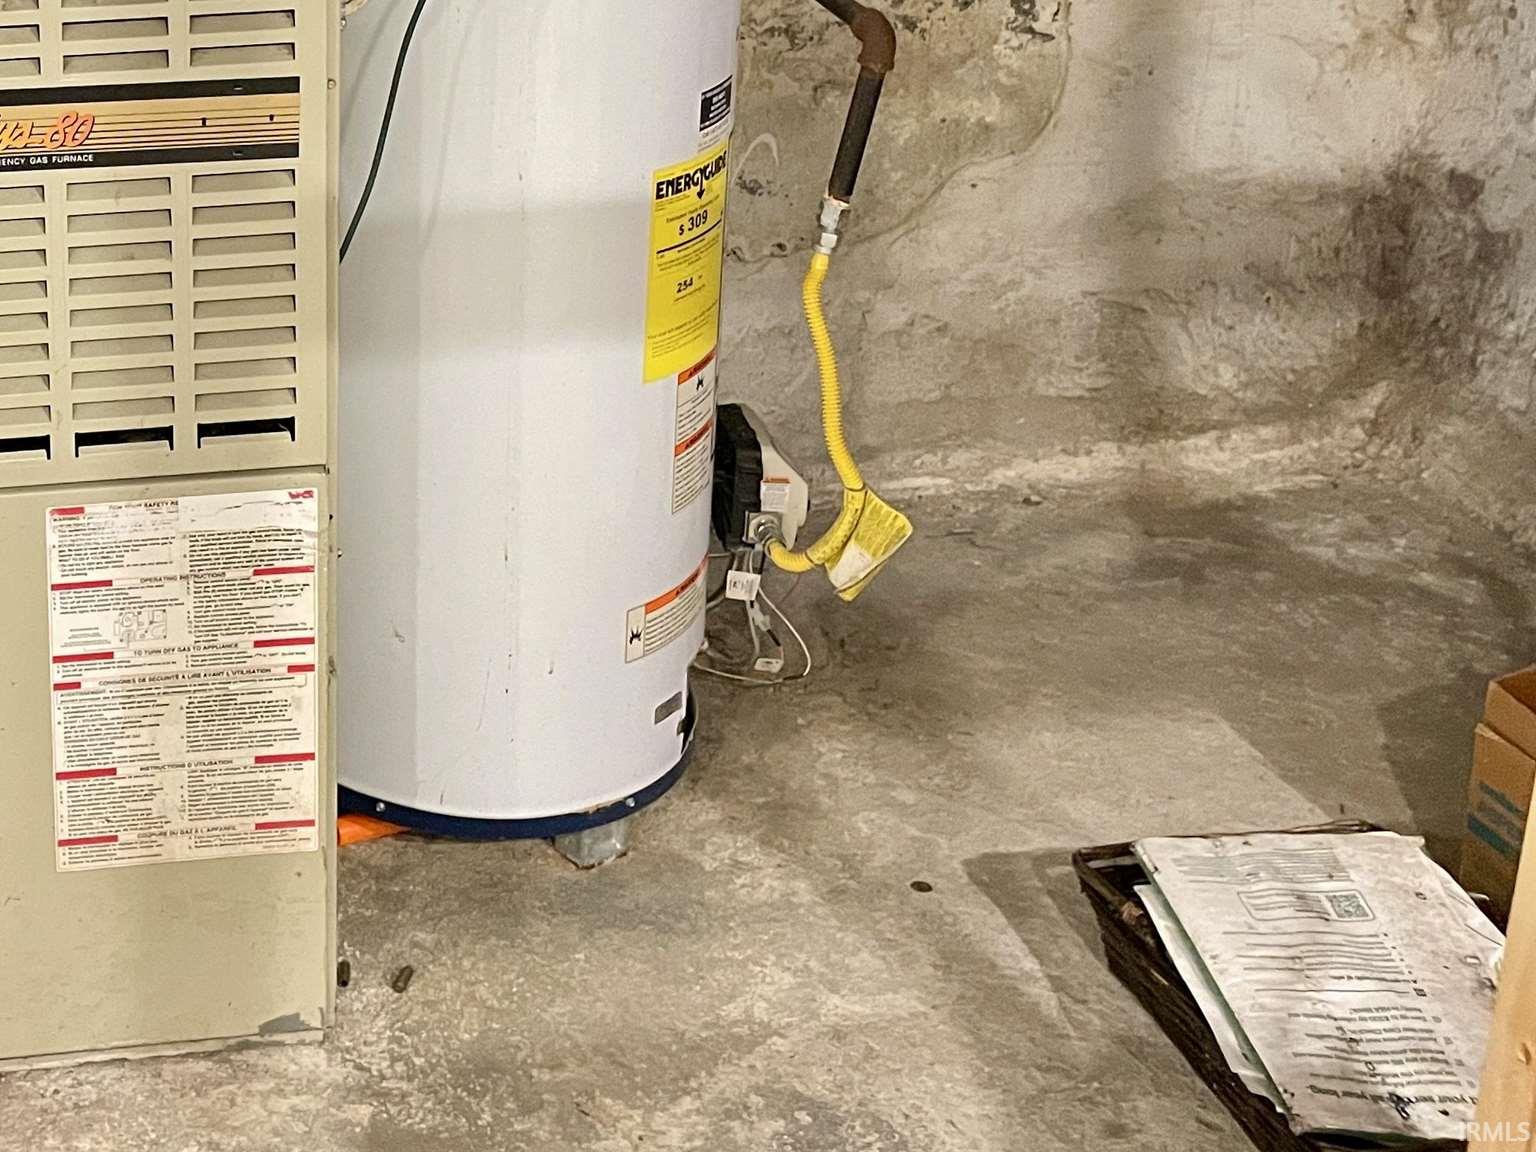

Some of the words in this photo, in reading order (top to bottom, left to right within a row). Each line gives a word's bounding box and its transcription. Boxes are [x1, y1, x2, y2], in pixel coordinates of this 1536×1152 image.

[43, 110, 96, 149] 80
[30, 156, 48, 165] GAS
[52, 154, 94, 164] FURNACE
[687, 209, 708, 232] 309
